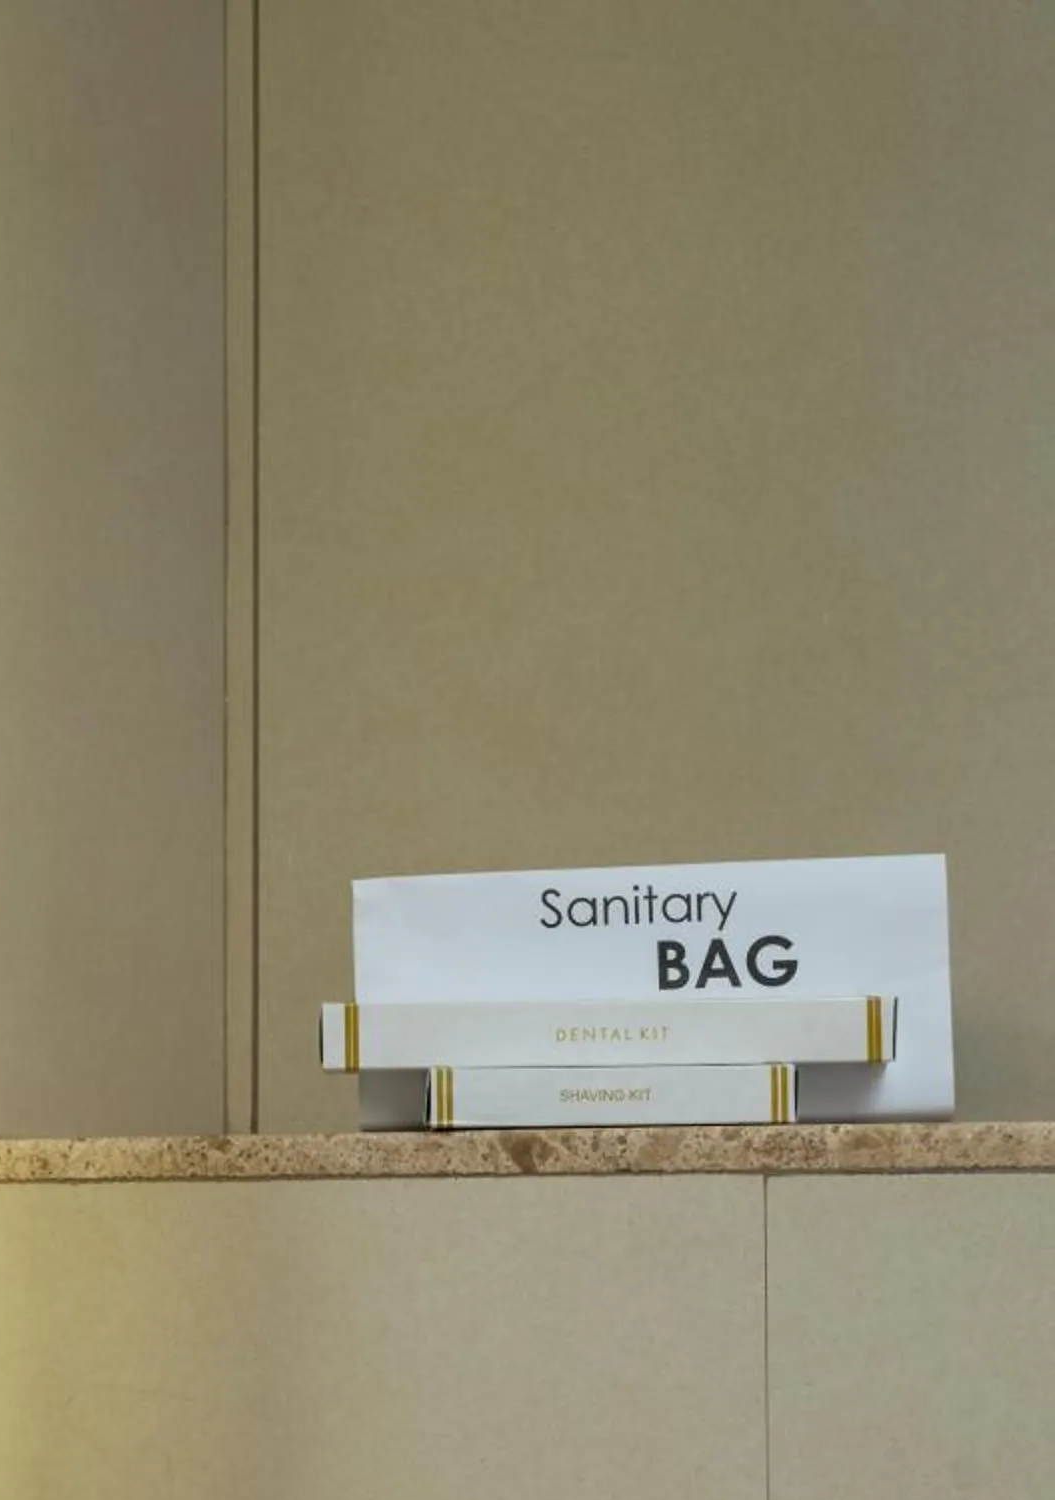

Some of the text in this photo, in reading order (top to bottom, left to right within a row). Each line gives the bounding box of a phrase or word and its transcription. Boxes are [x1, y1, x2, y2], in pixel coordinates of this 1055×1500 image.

[540, 885, 737, 930] Sanitary
[657, 935, 799, 991] BAG
[556, 1026, 669, 1042] DENTAL KIT
[560, 1087, 651, 1103] SHAVING KIT
